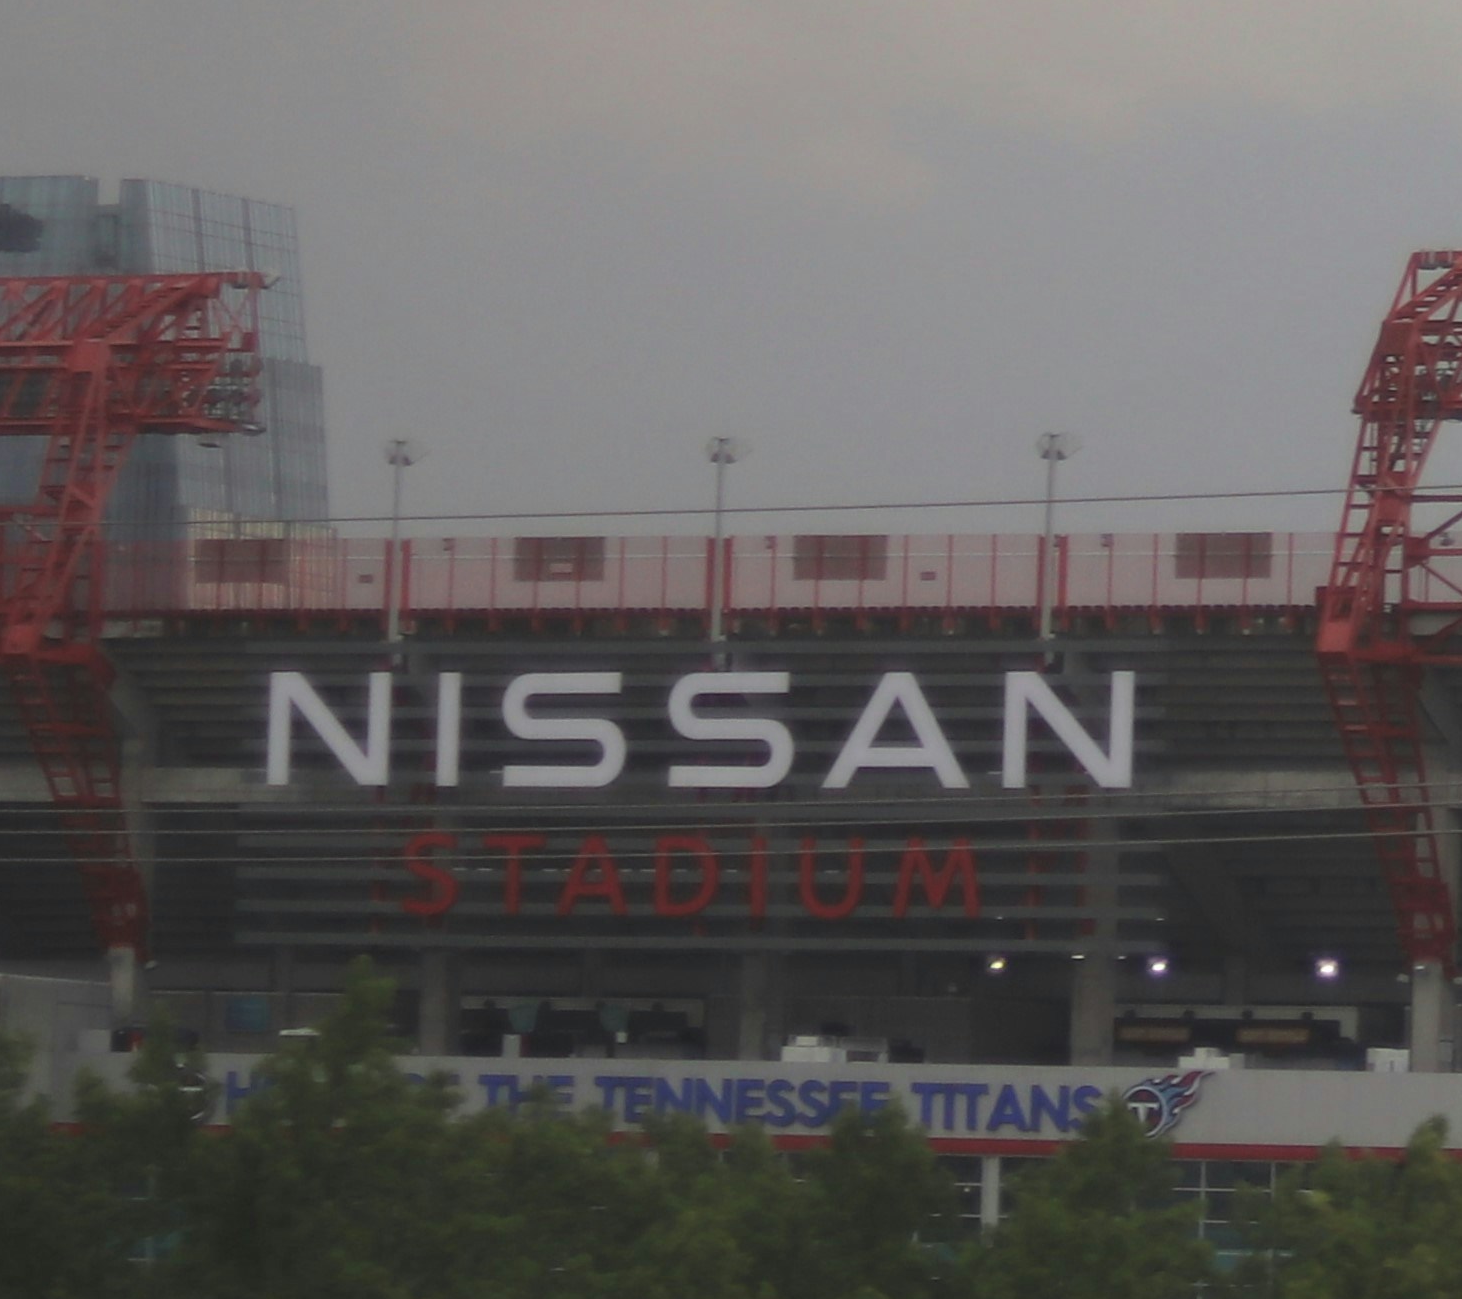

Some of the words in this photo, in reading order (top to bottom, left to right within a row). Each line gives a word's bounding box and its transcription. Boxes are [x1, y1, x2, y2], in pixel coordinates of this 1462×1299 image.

[265, 669, 1137, 789] NISSAN
[398, 829, 984, 919] STADIUM
[910, 1081, 1103, 1133] TITANS
